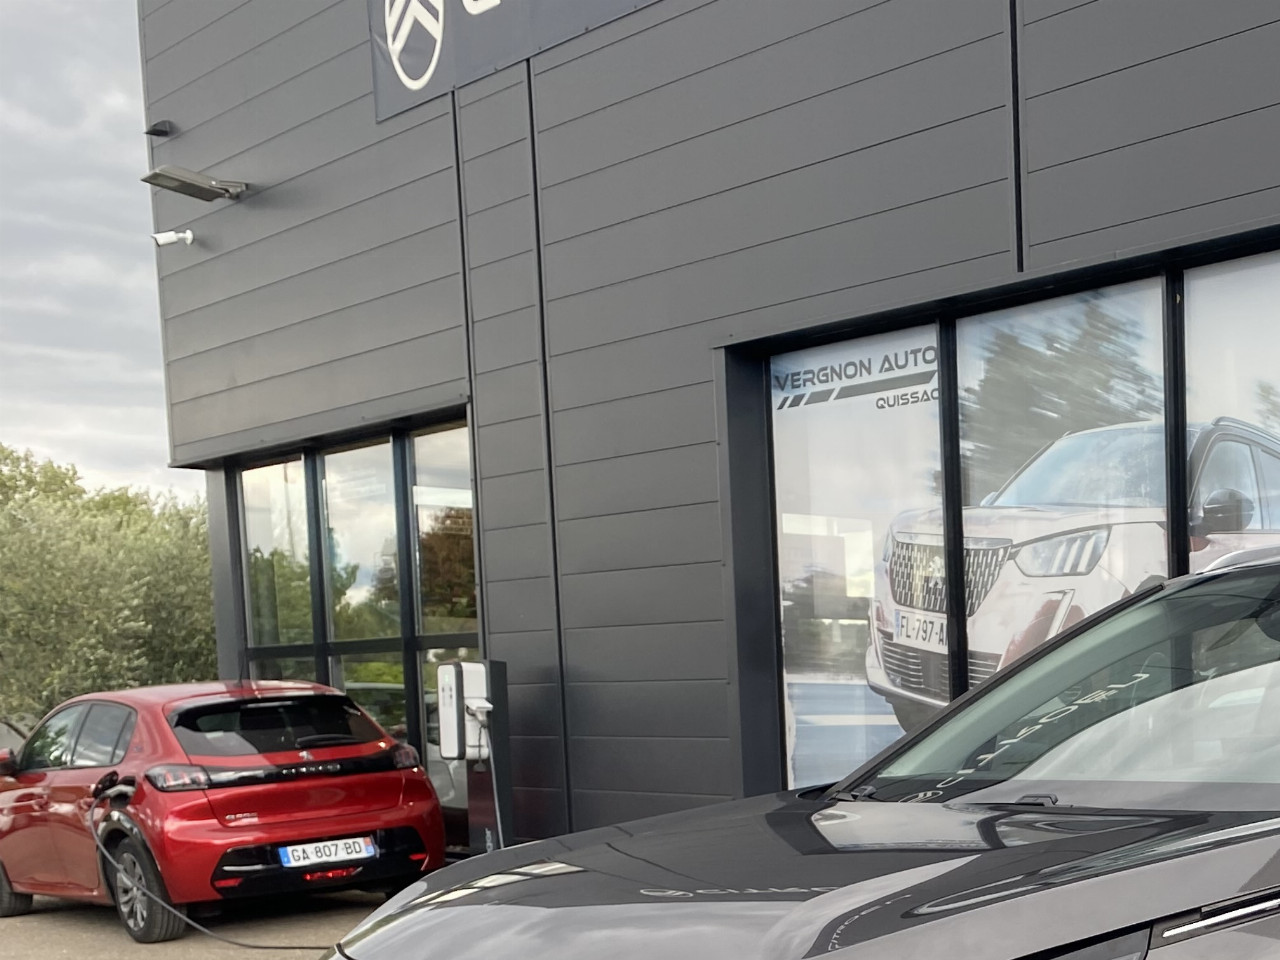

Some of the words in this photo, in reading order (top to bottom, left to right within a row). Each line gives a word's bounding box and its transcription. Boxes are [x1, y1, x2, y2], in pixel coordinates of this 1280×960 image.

[775, 357, 872, 391] VERGNON
[879, 346, 937, 373] AUTO
[876, 388, 940, 410] QUISSAC
[900, 615, 947, 647] FL-797-A
